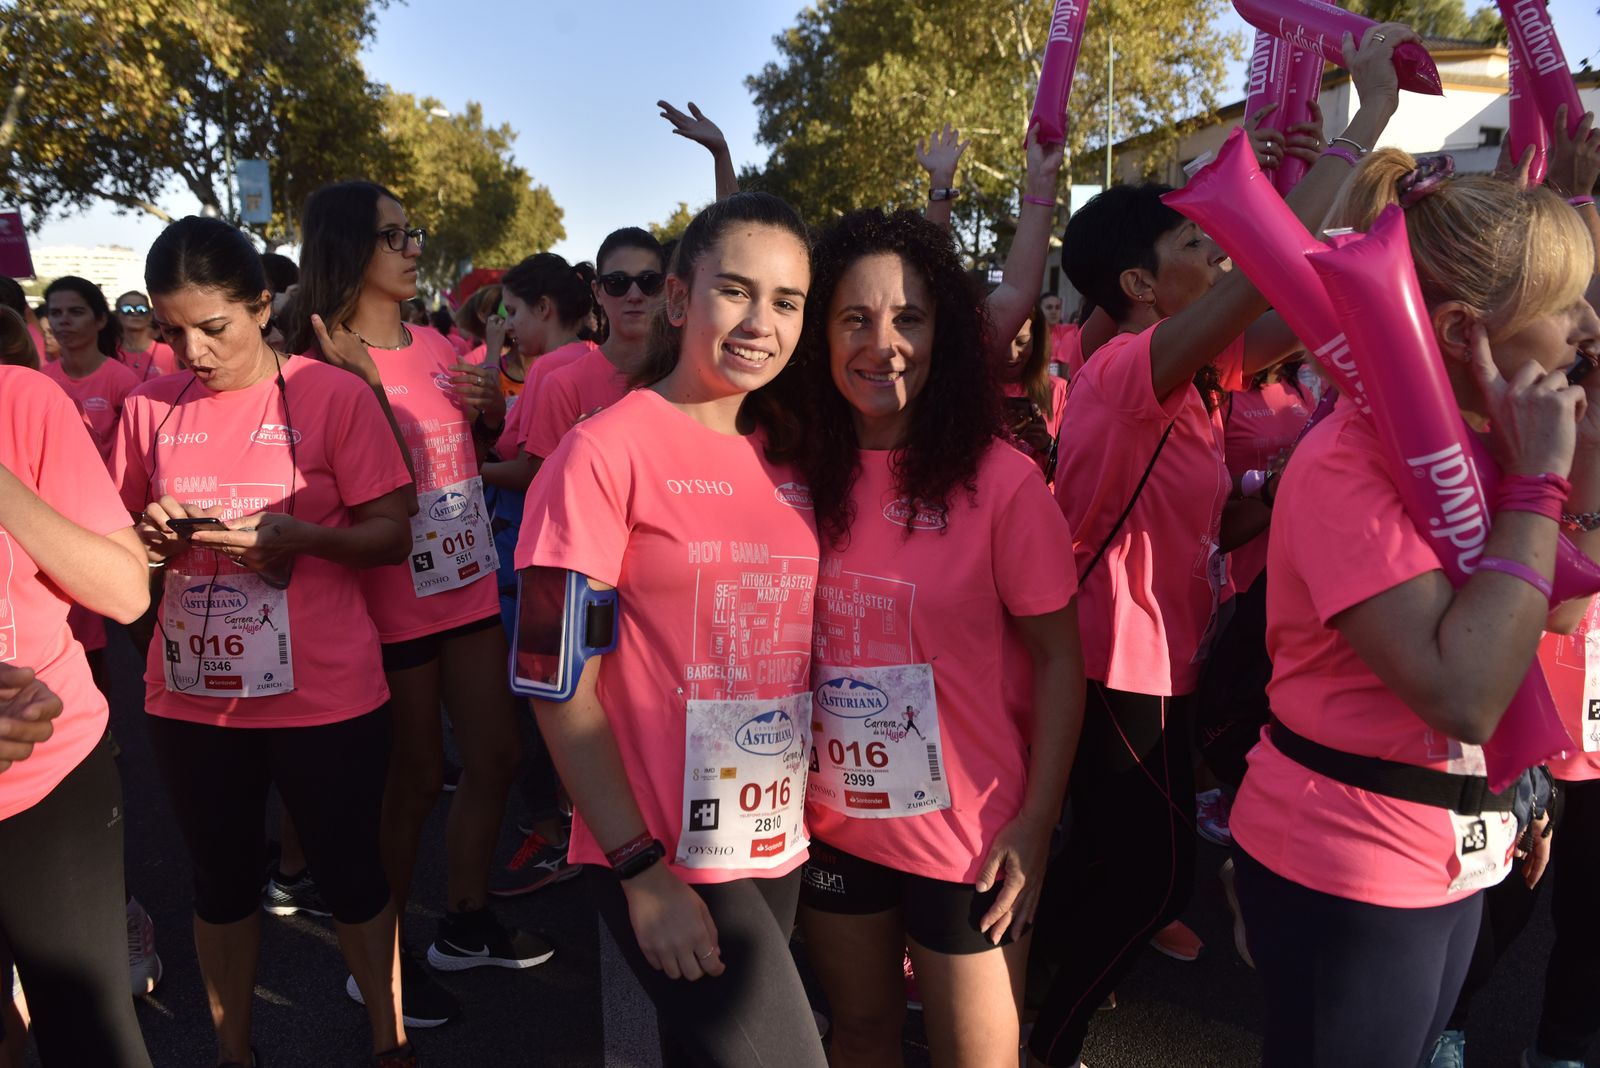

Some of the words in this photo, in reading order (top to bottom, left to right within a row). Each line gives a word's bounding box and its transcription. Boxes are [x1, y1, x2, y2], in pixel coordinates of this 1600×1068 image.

[1050, 0, 1080, 43] dival
[1248, 28, 1271, 96] Ladiva
[666, 479, 734, 497] OYSHO
[1406, 442, 1487, 576] adival
[442, 528, 476, 556] 016
[455, 551, 473, 566] 5511
[687, 541, 722, 564] HOY
[730, 541, 769, 565] GANAN
[741, 573, 773, 588] VITORIA
[780, 575, 813, 590] GASTEIZ
[183, 597, 242, 609] ASTURIANA
[757, 587, 790, 602] MADRID
[852, 591, 894, 611] GASTEIZ
[827, 601, 866, 618] MADRID
[224, 615, 254, 624] Carrera
[189, 634, 245, 657] 016
[203, 661, 232, 672] 5346
[686, 664, 748, 680] BARCELONA
[756, 656, 803, 685] CHICAS
[256, 681, 283, 690] ZURICH
[821, 690, 883, 709] ASTURIANA
[864, 718, 896, 729] Carrera
[742, 725, 793, 746] ASTURIANA
[884, 730, 908, 743] Mujer
[828, 738, 889, 768] 016
[843, 772, 875, 787] 2999
[740, 776, 790, 812] 016
[906, 798, 938, 809] ZURICH
[754, 814, 782, 833] 2810
[687, 845, 735, 856] OYSHO
